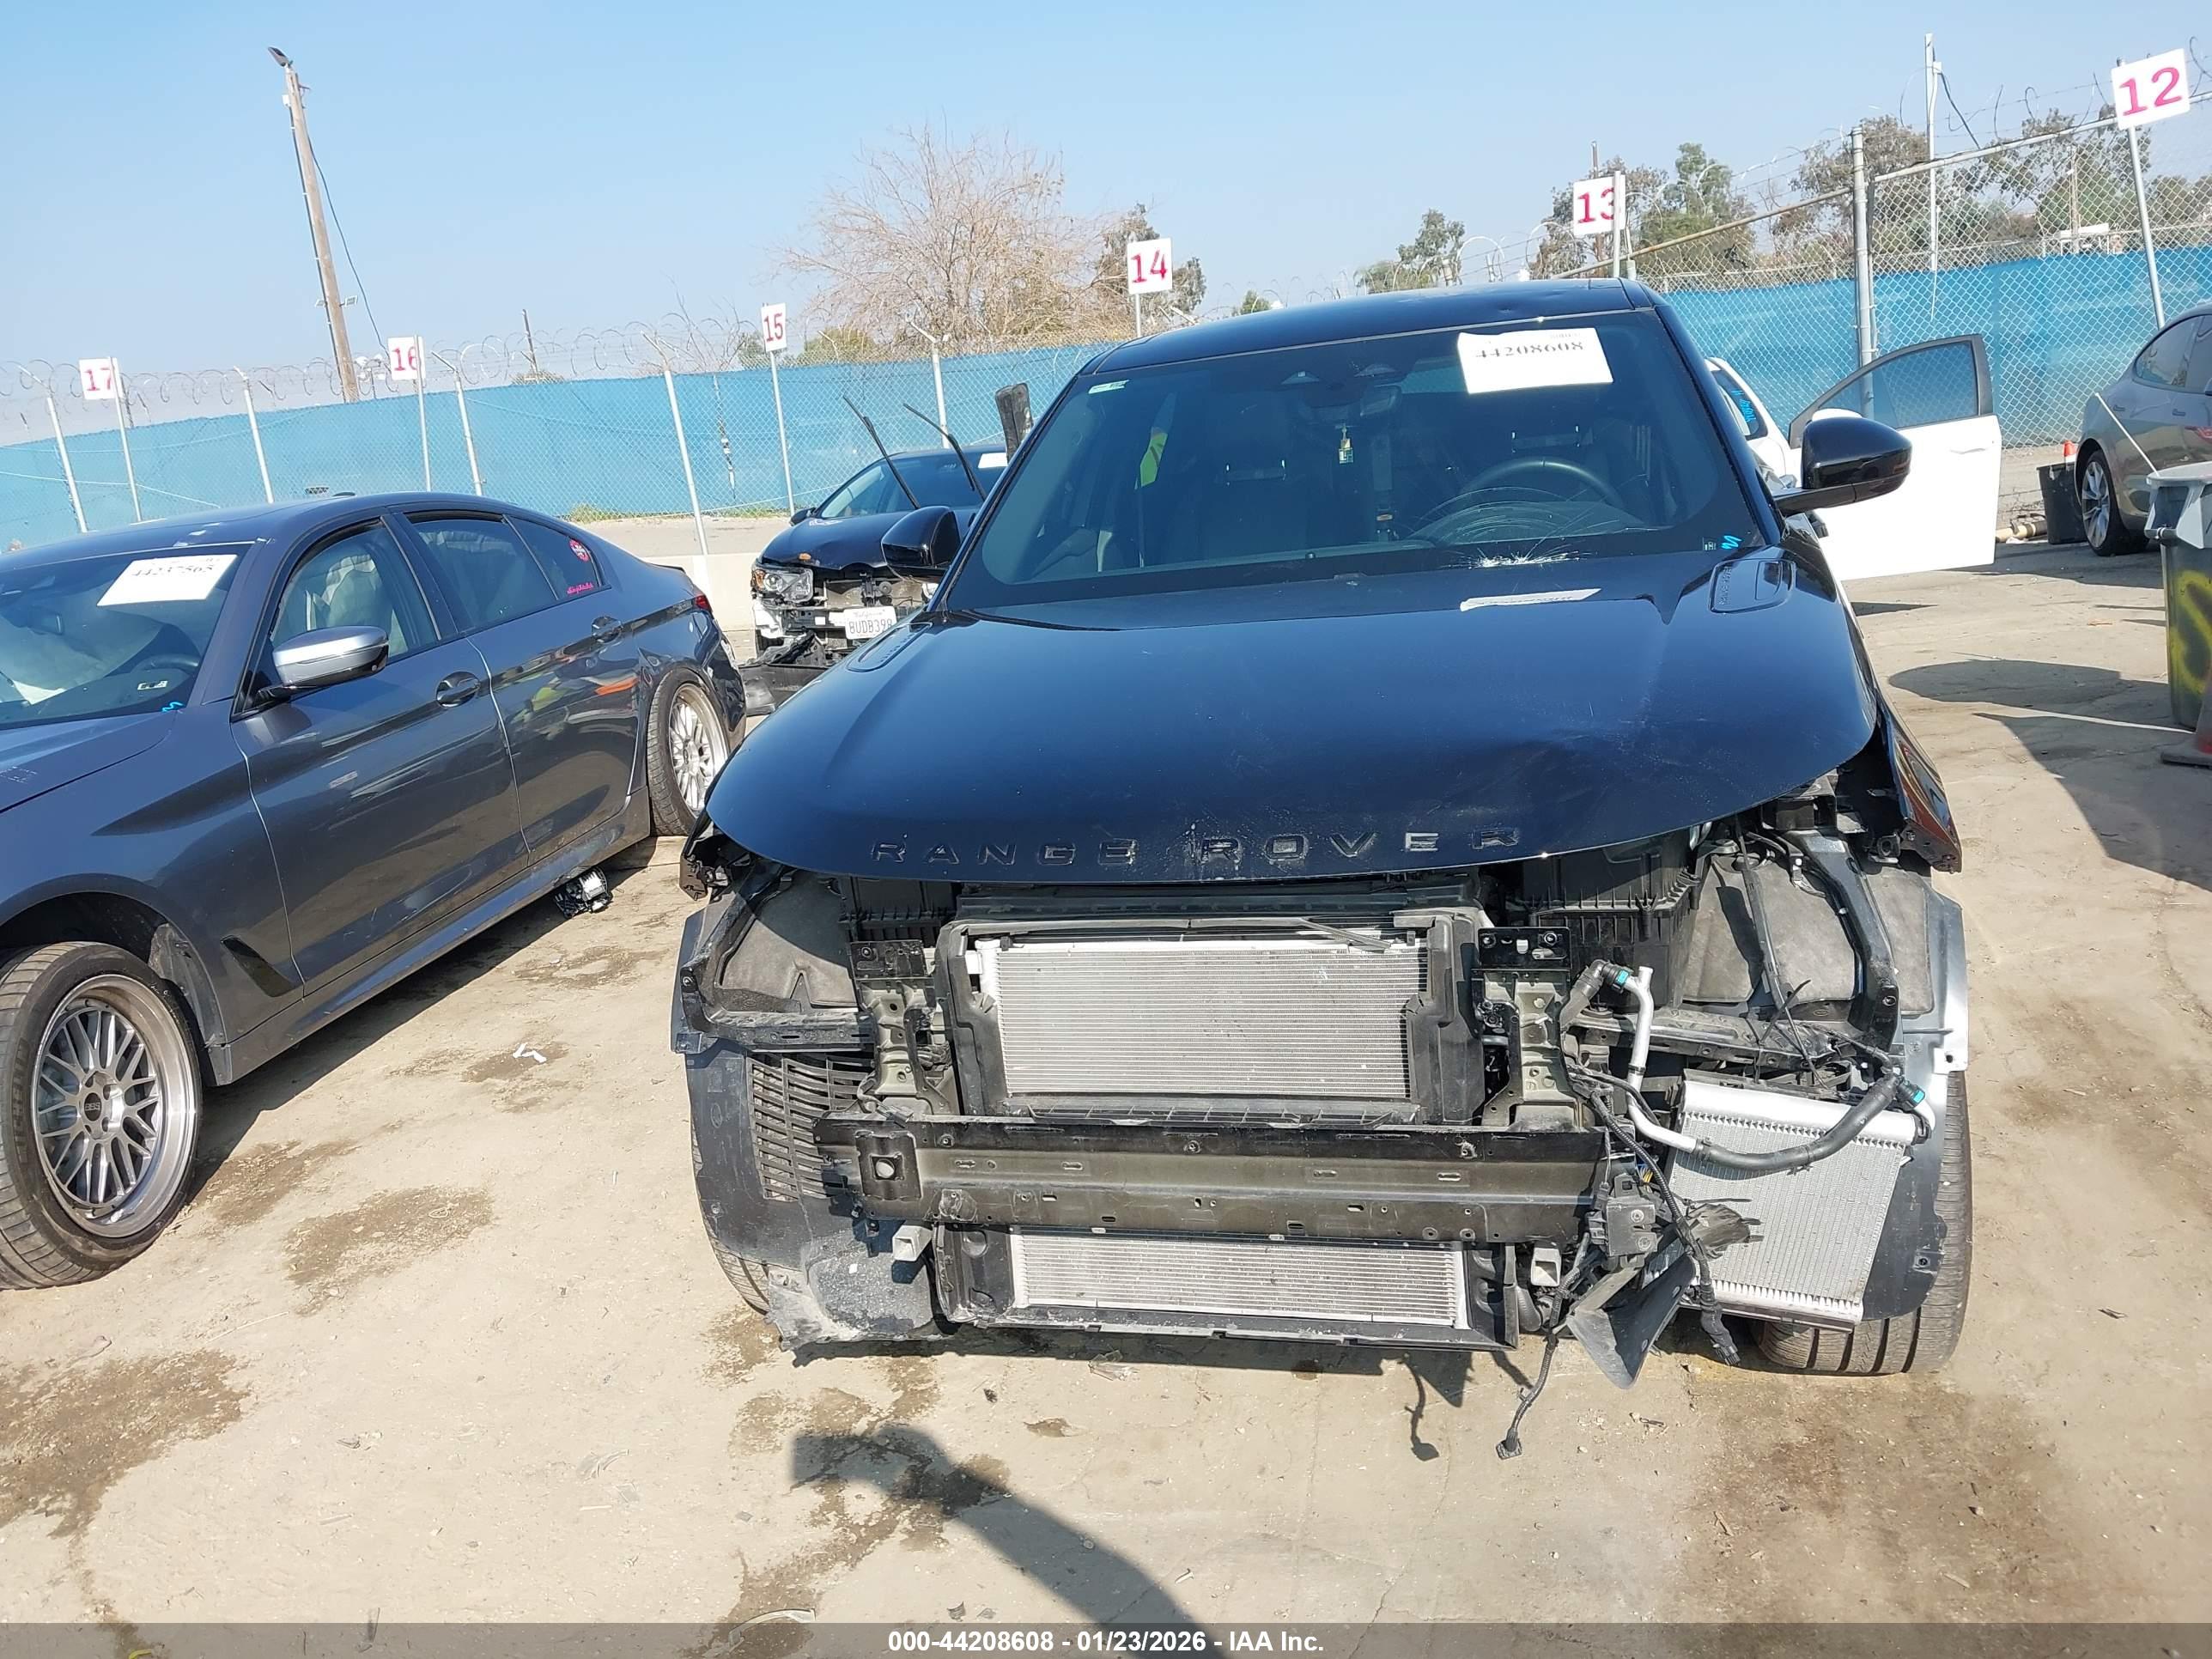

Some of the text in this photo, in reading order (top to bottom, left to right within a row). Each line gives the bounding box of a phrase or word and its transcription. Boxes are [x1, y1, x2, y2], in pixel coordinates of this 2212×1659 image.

[2119, 67, 2182, 116] 12
[1577, 187, 1614, 223] 13
[1131, 249, 1168, 283] 14
[763, 312, 783, 342] 15
[392, 345, 418, 371] 16
[1476, 341, 1583, 358] 44208608
[83, 367, 112, 391] 17
[870, 827, 1520, 866] RANGE ROVER
